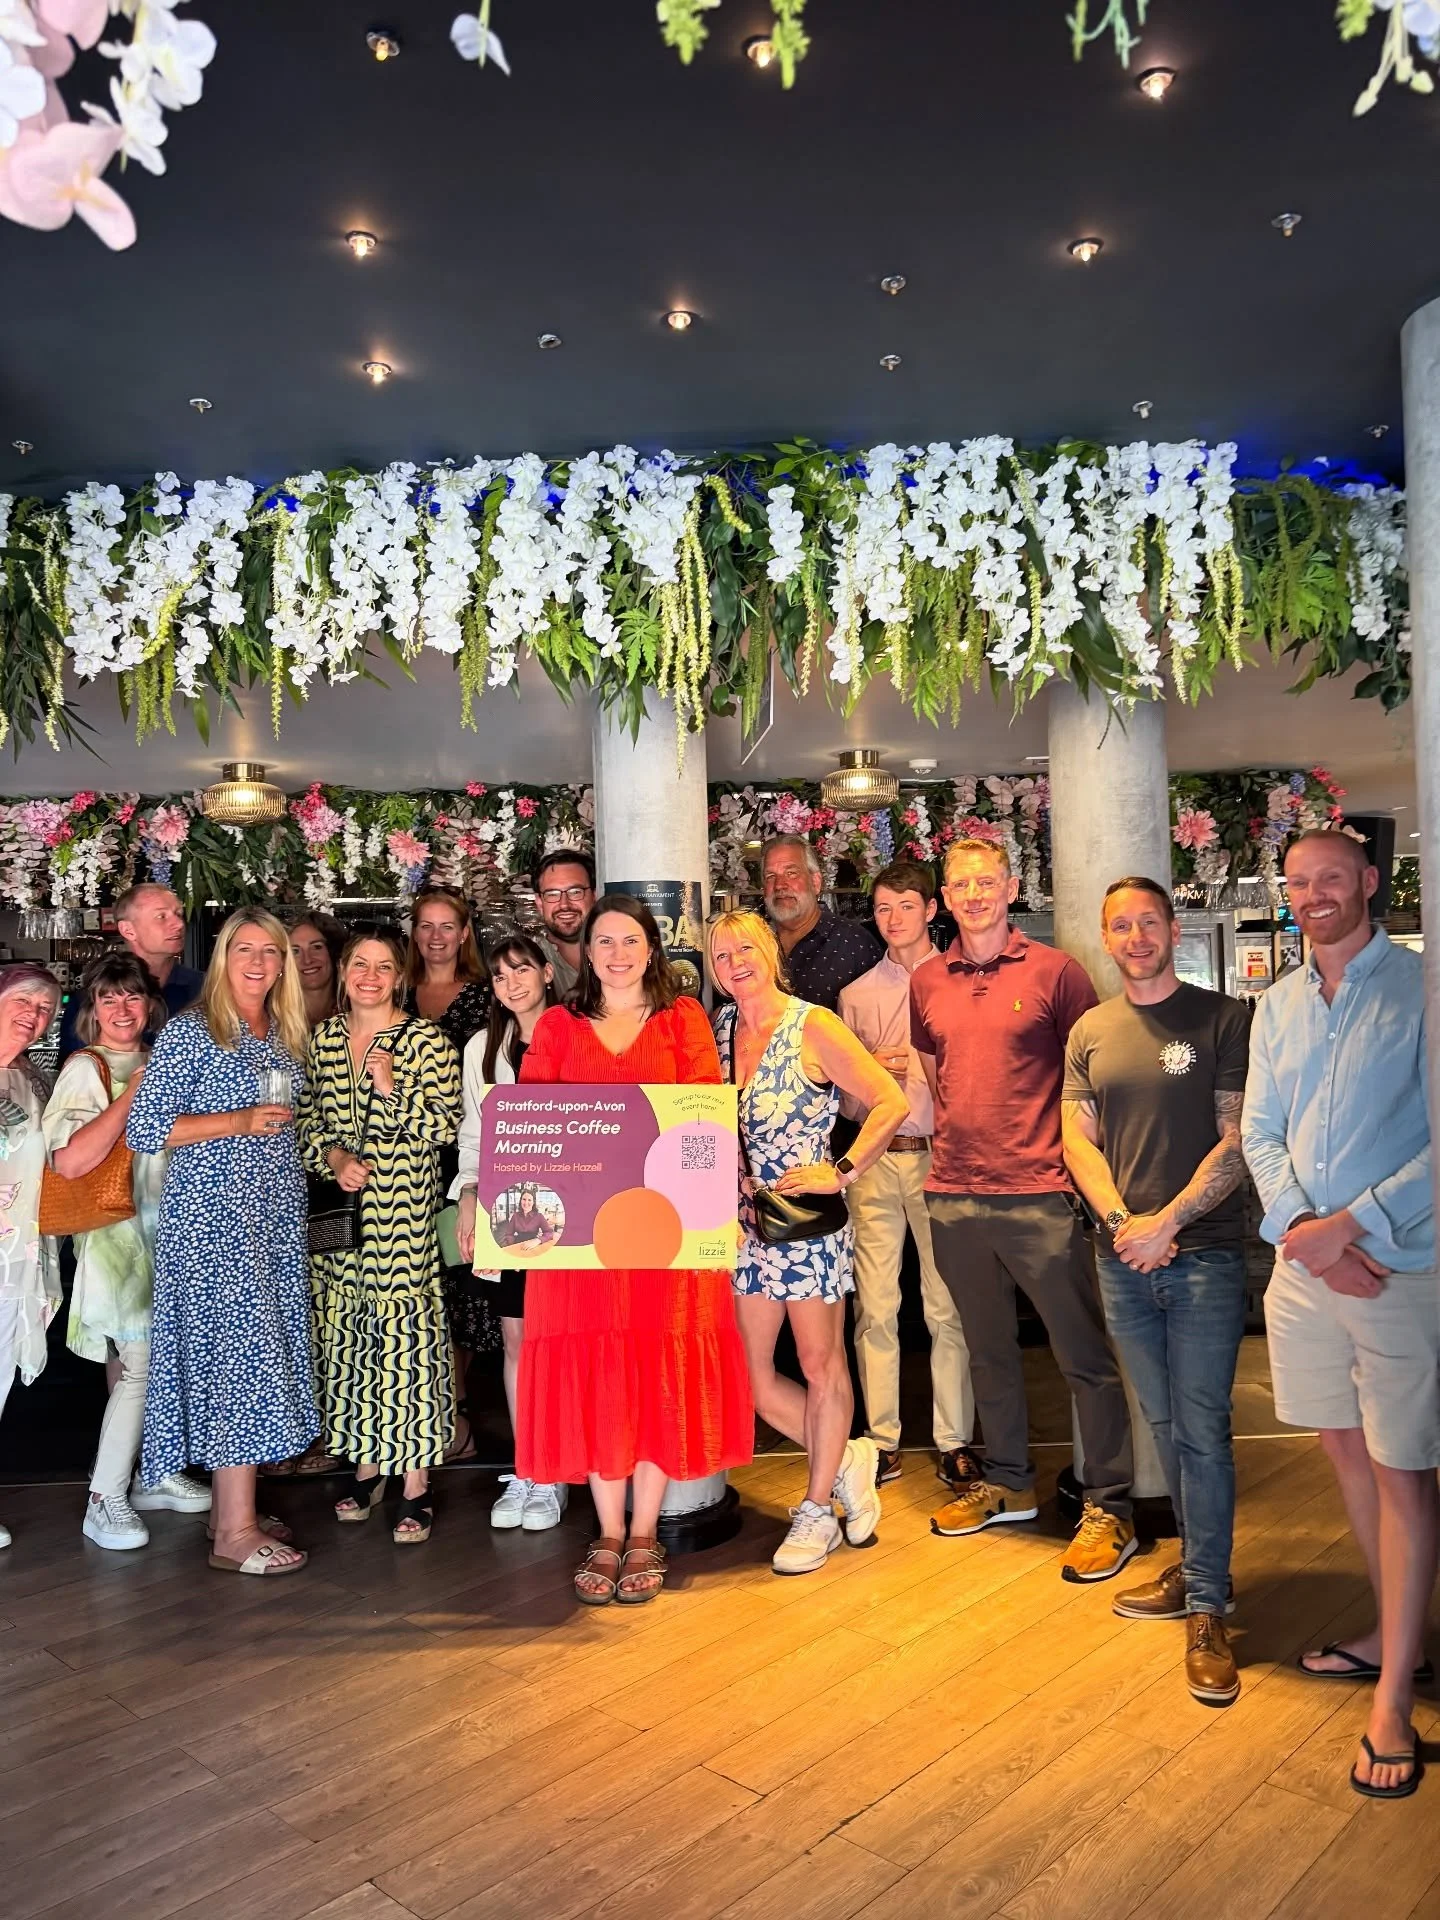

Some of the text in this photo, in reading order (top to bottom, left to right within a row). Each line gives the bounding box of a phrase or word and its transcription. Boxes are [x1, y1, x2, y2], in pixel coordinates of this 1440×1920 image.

[496, 1100, 626, 1114] Stratford-upon-Avon
[495, 1120, 621, 1135] Business Coffee
[494, 1140, 563, 1158] Morning
[493, 1163, 603, 1175] Hosted by Lizzie Hazell
[699, 1245, 727, 1256] lizzie
